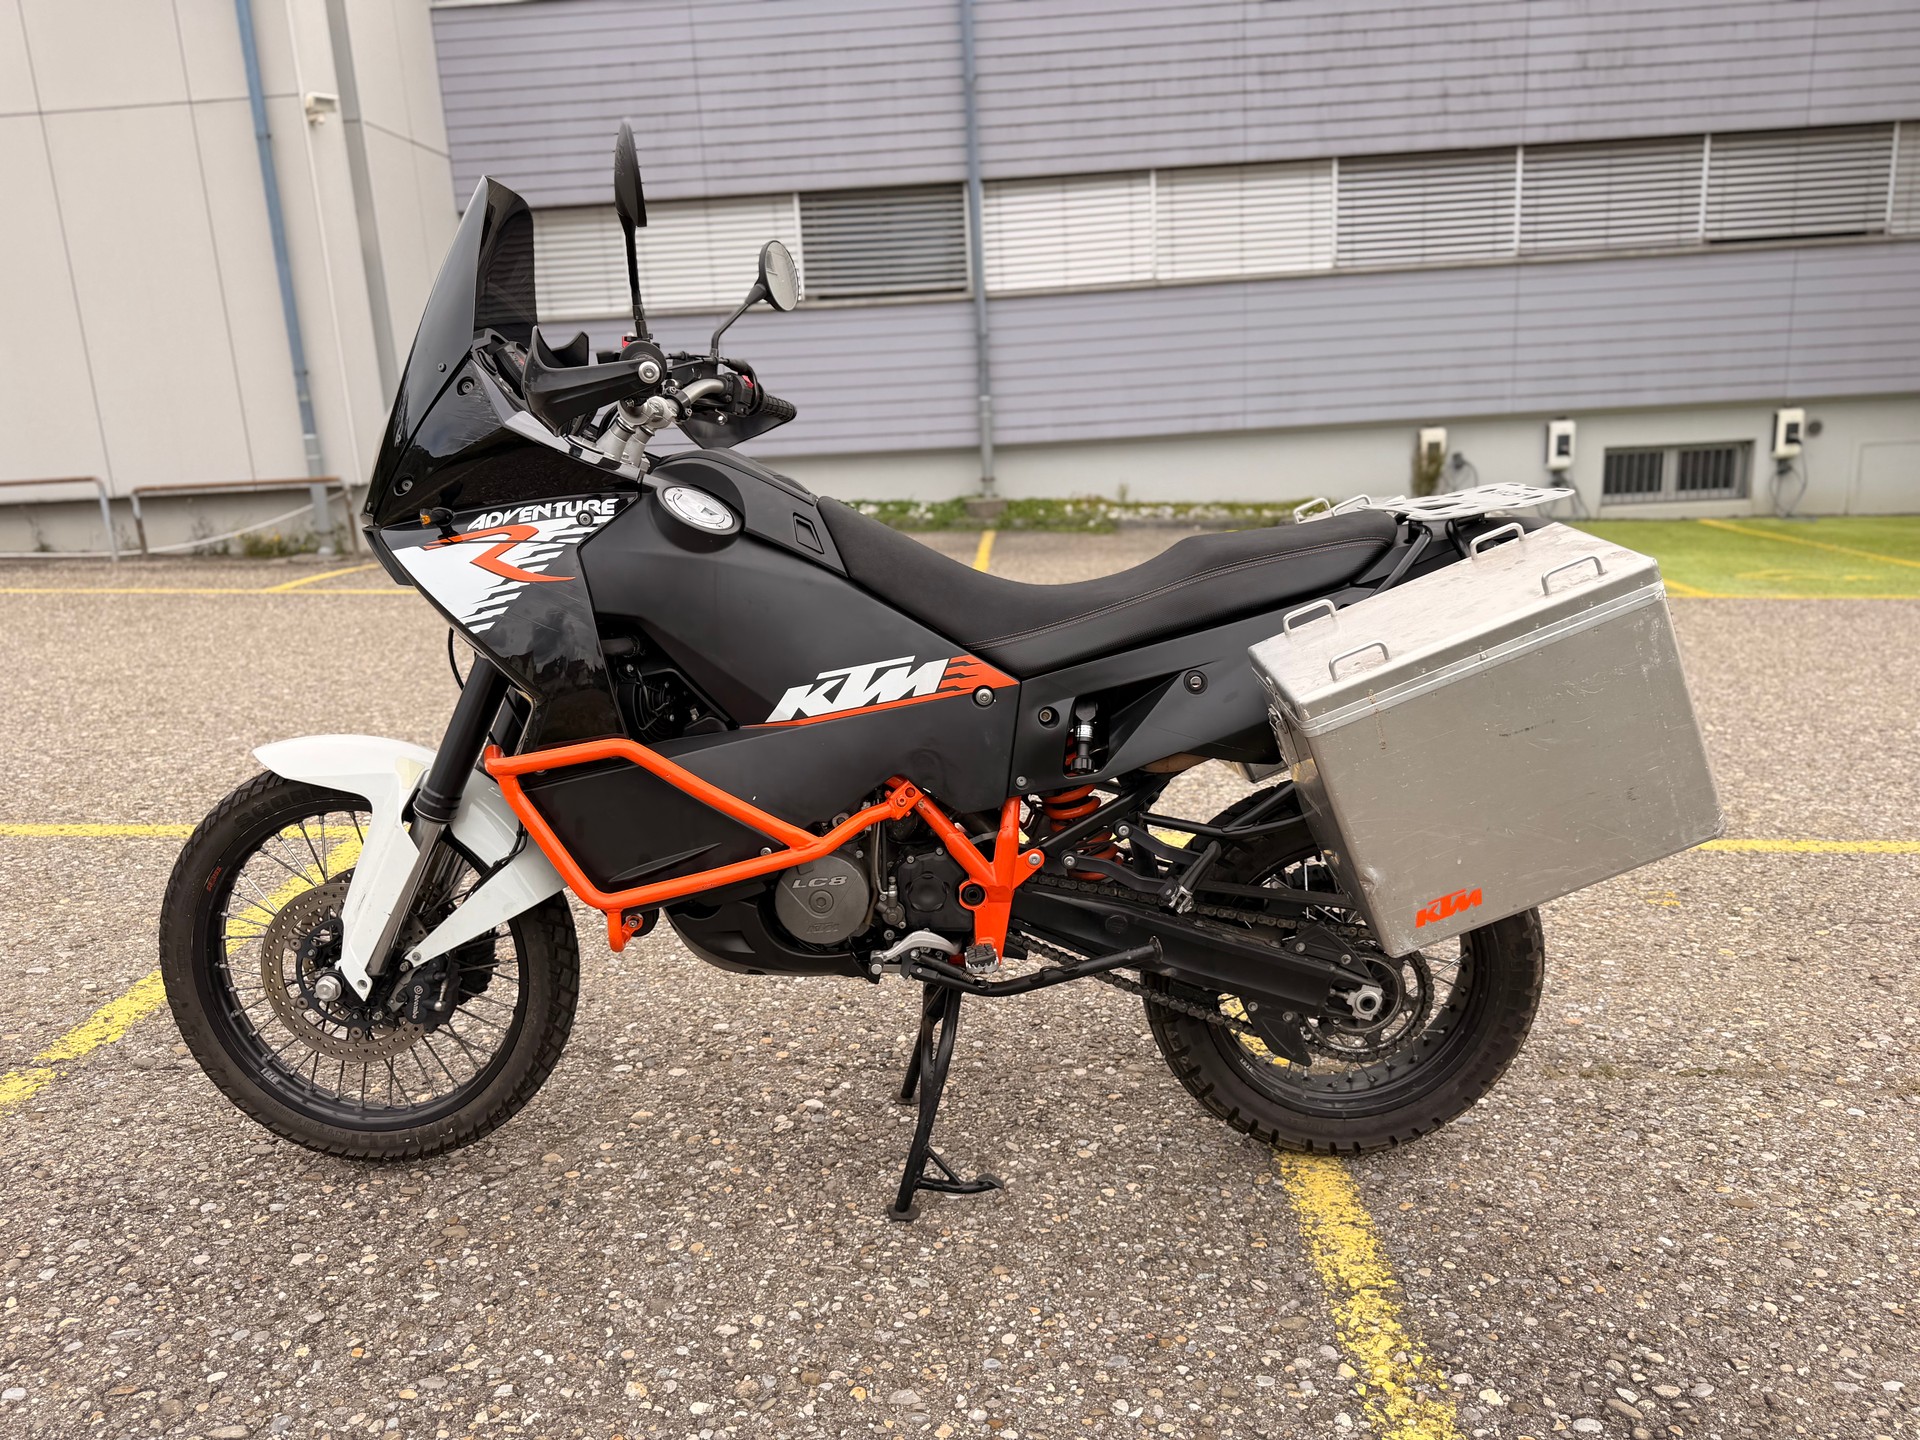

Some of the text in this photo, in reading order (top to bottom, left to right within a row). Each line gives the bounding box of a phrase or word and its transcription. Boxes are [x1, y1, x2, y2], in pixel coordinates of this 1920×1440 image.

[467, 499, 619, 531] ADVENTURE
[423, 525, 576, 582] R
[765, 655, 949, 723] KTM
[792, 875, 848, 889] LC8
[1415, 887, 1482, 928] KTM
